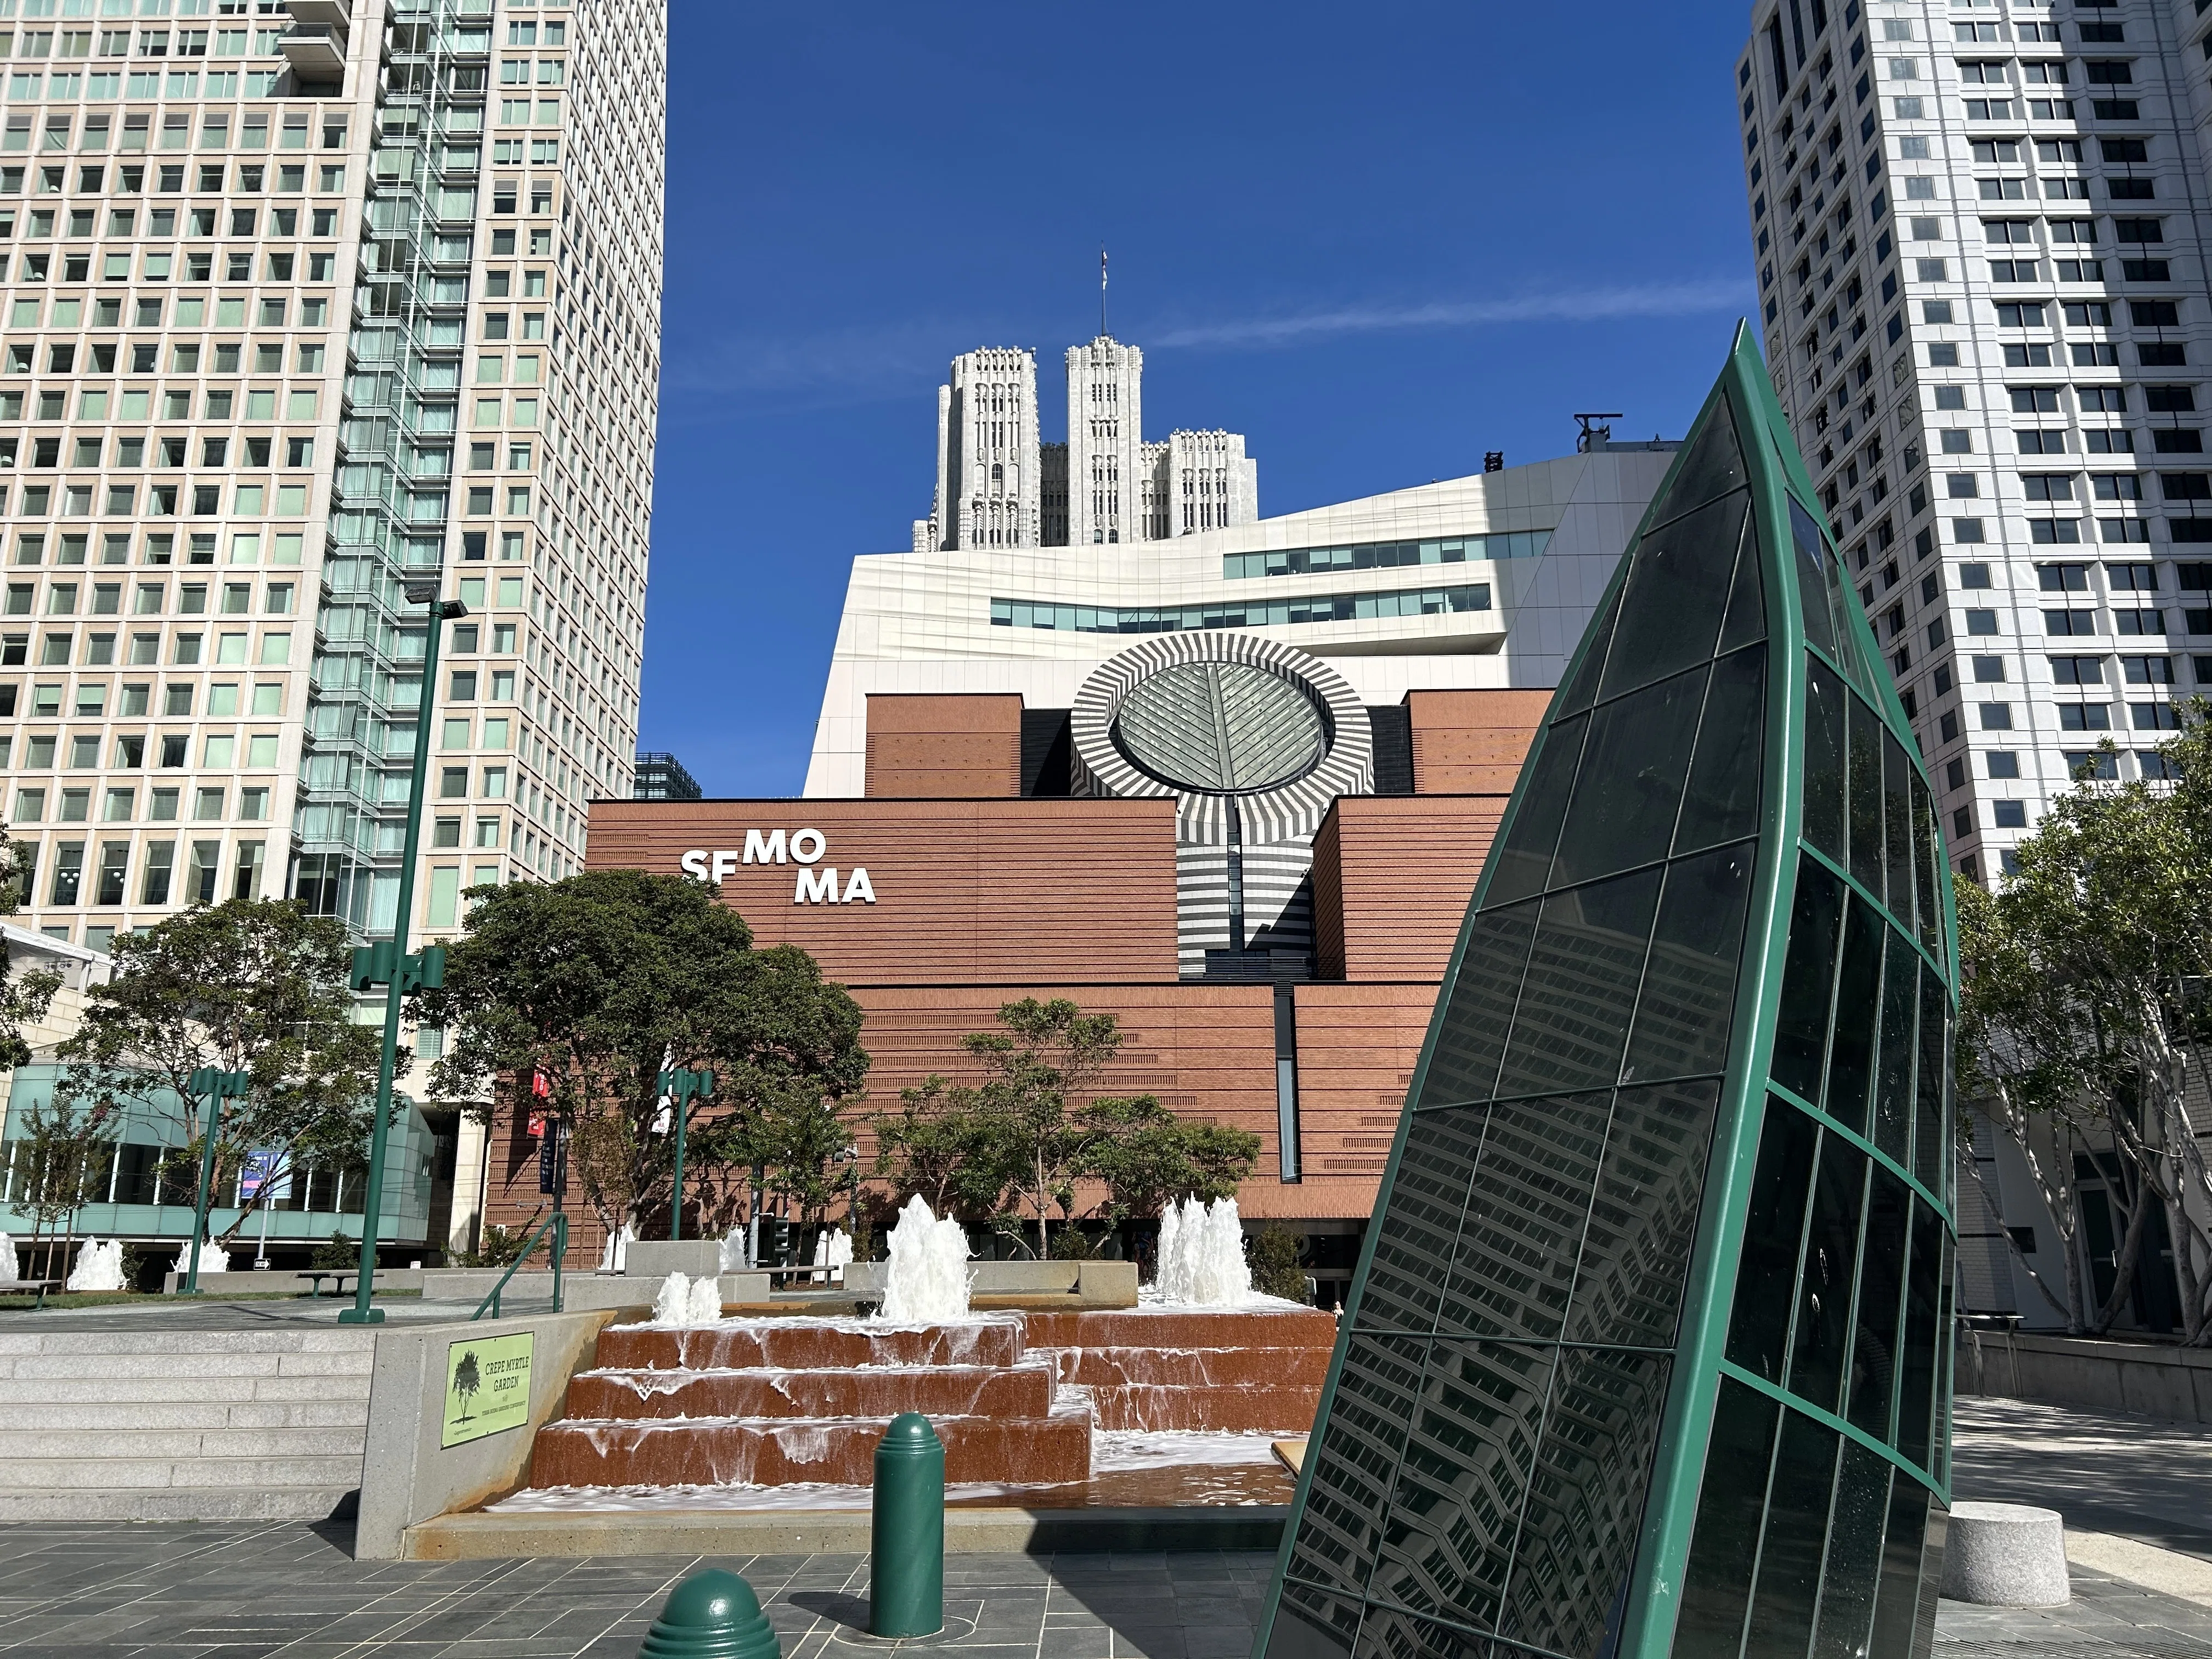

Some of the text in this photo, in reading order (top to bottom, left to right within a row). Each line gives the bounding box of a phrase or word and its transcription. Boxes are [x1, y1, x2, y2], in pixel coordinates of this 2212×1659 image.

[742, 828, 826, 864] MO
[681, 850, 738, 885] SF
[794, 867, 877, 903] MA
[486, 1357, 529, 1375] CREPE MYRTLE
[494, 1375, 519, 1392] GARDEN
